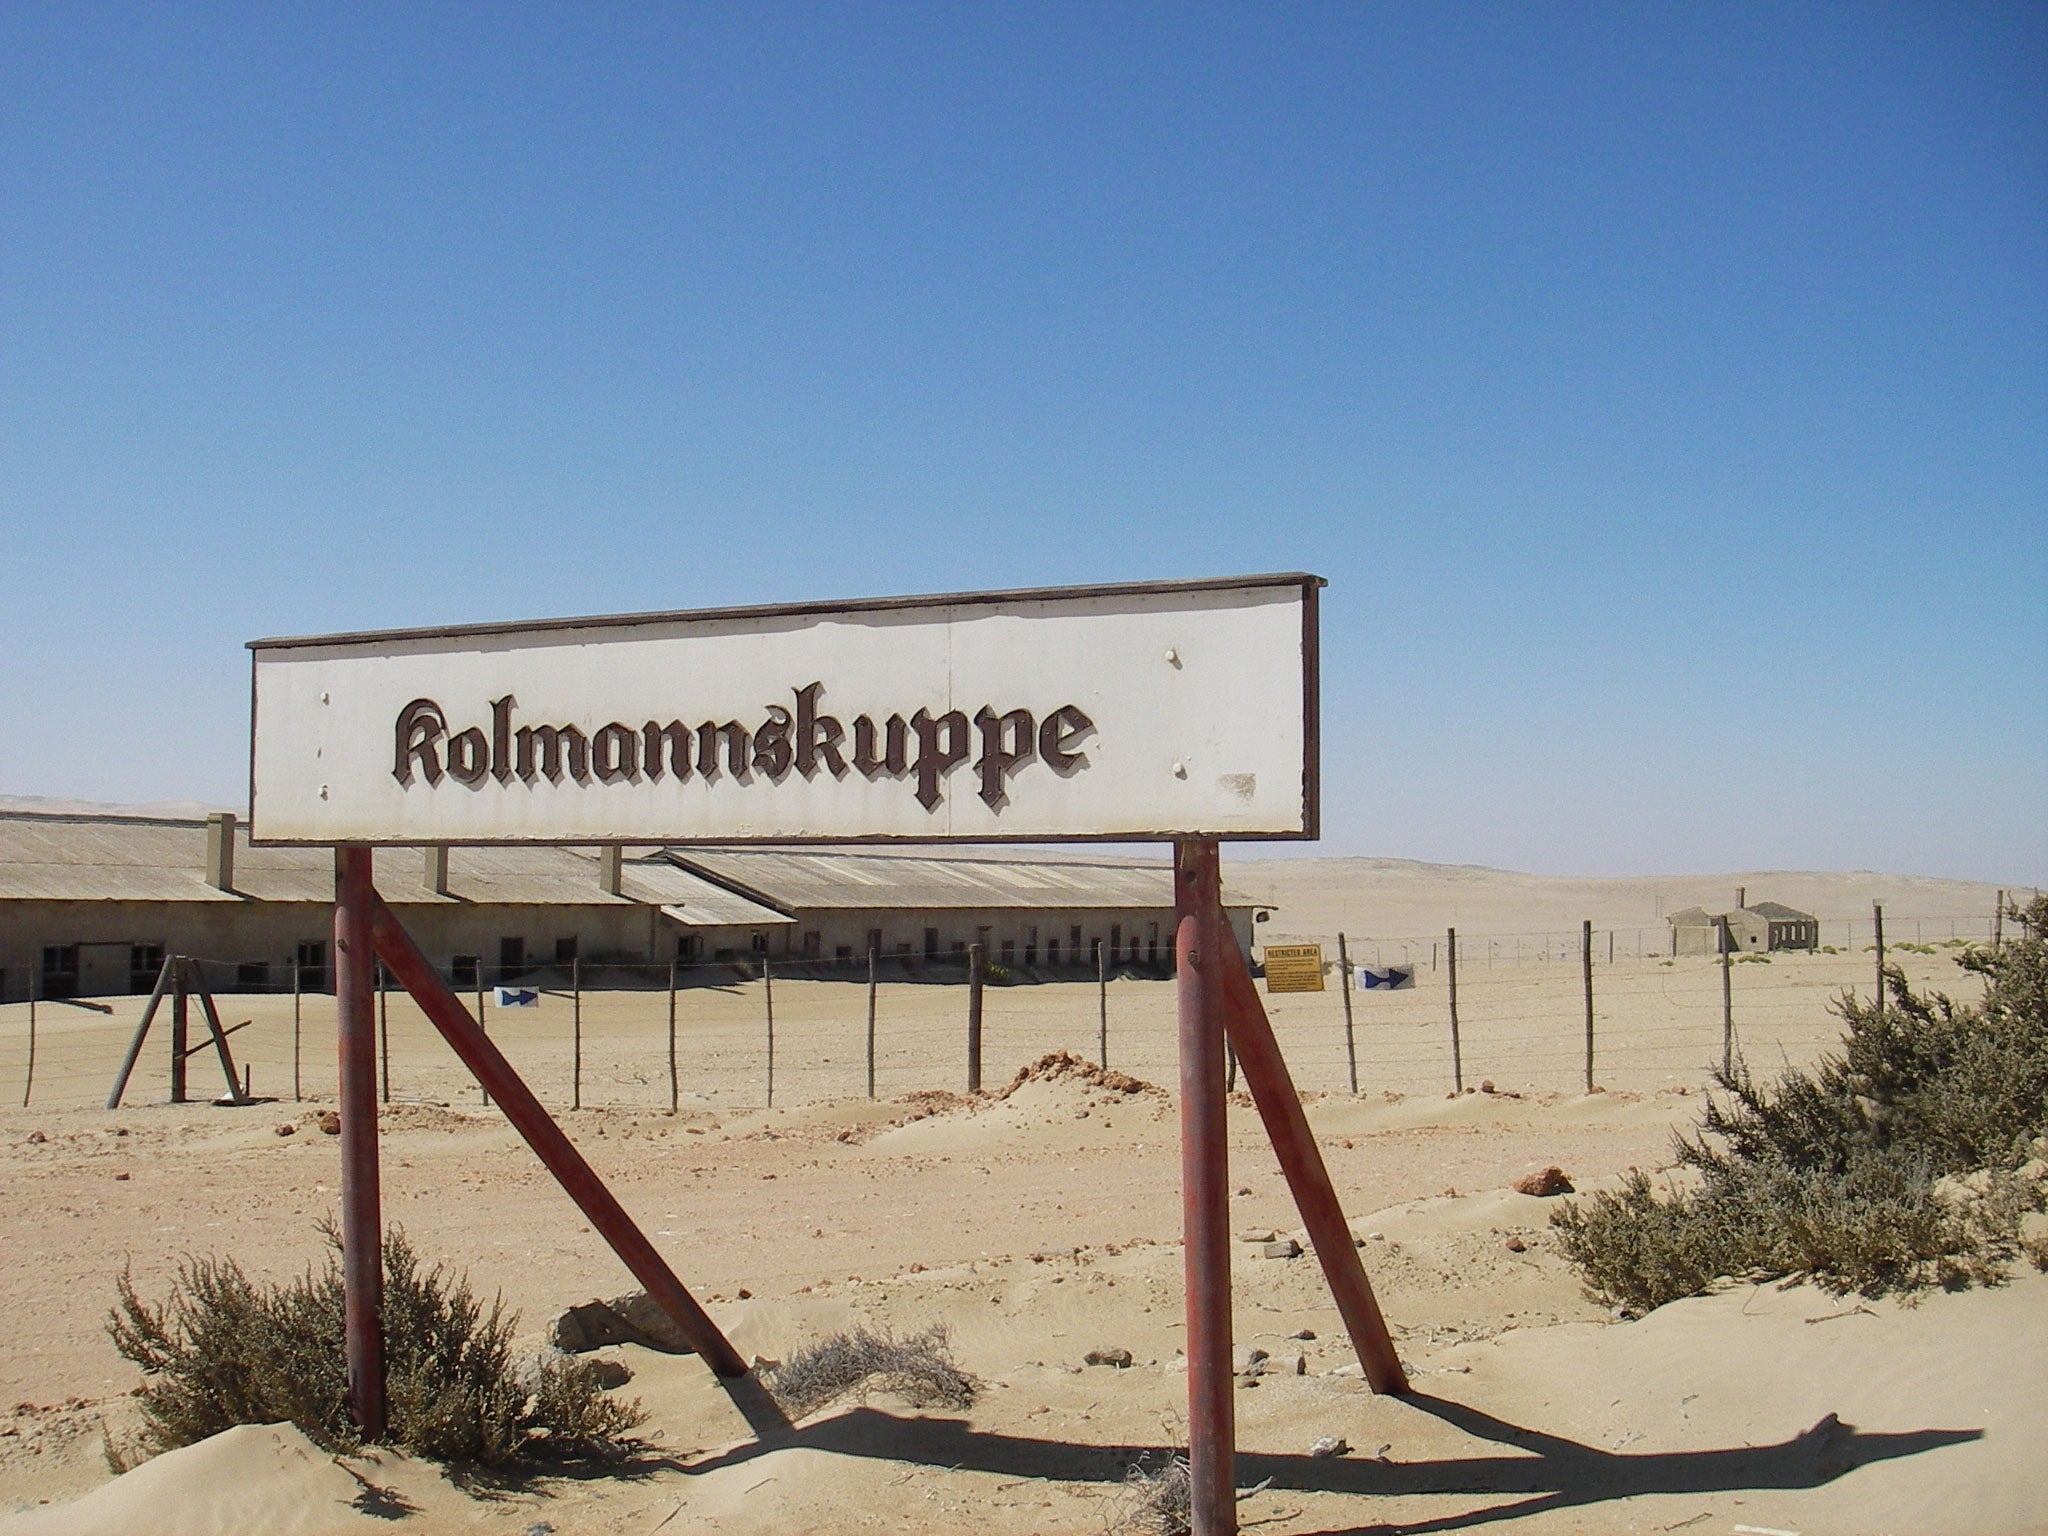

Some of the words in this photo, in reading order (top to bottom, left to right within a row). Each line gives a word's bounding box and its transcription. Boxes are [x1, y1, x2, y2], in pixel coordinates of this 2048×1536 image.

[391, 681, 1094, 811] Kolmannskuppe
[1267, 948, 1301, 958] RESTRICTED
[1302, 948, 1318, 957] AREA
